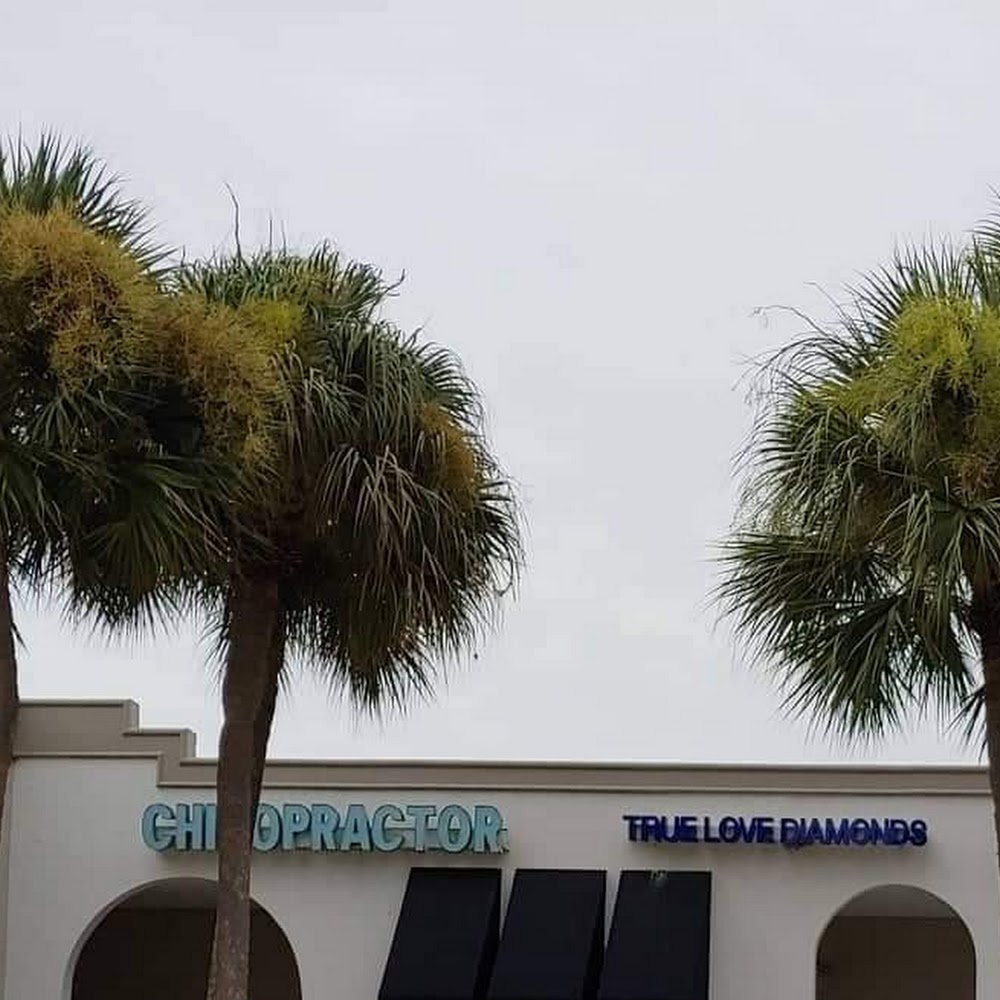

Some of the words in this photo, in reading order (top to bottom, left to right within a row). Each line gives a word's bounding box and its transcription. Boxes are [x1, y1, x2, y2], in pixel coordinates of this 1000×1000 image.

[141, 804, 502, 853] CHIOPRACTOR
[623, 815, 698, 843] TRUE
[704, 816, 773, 844] LOVE
[779, 818, 928, 847] DIAMONDS
